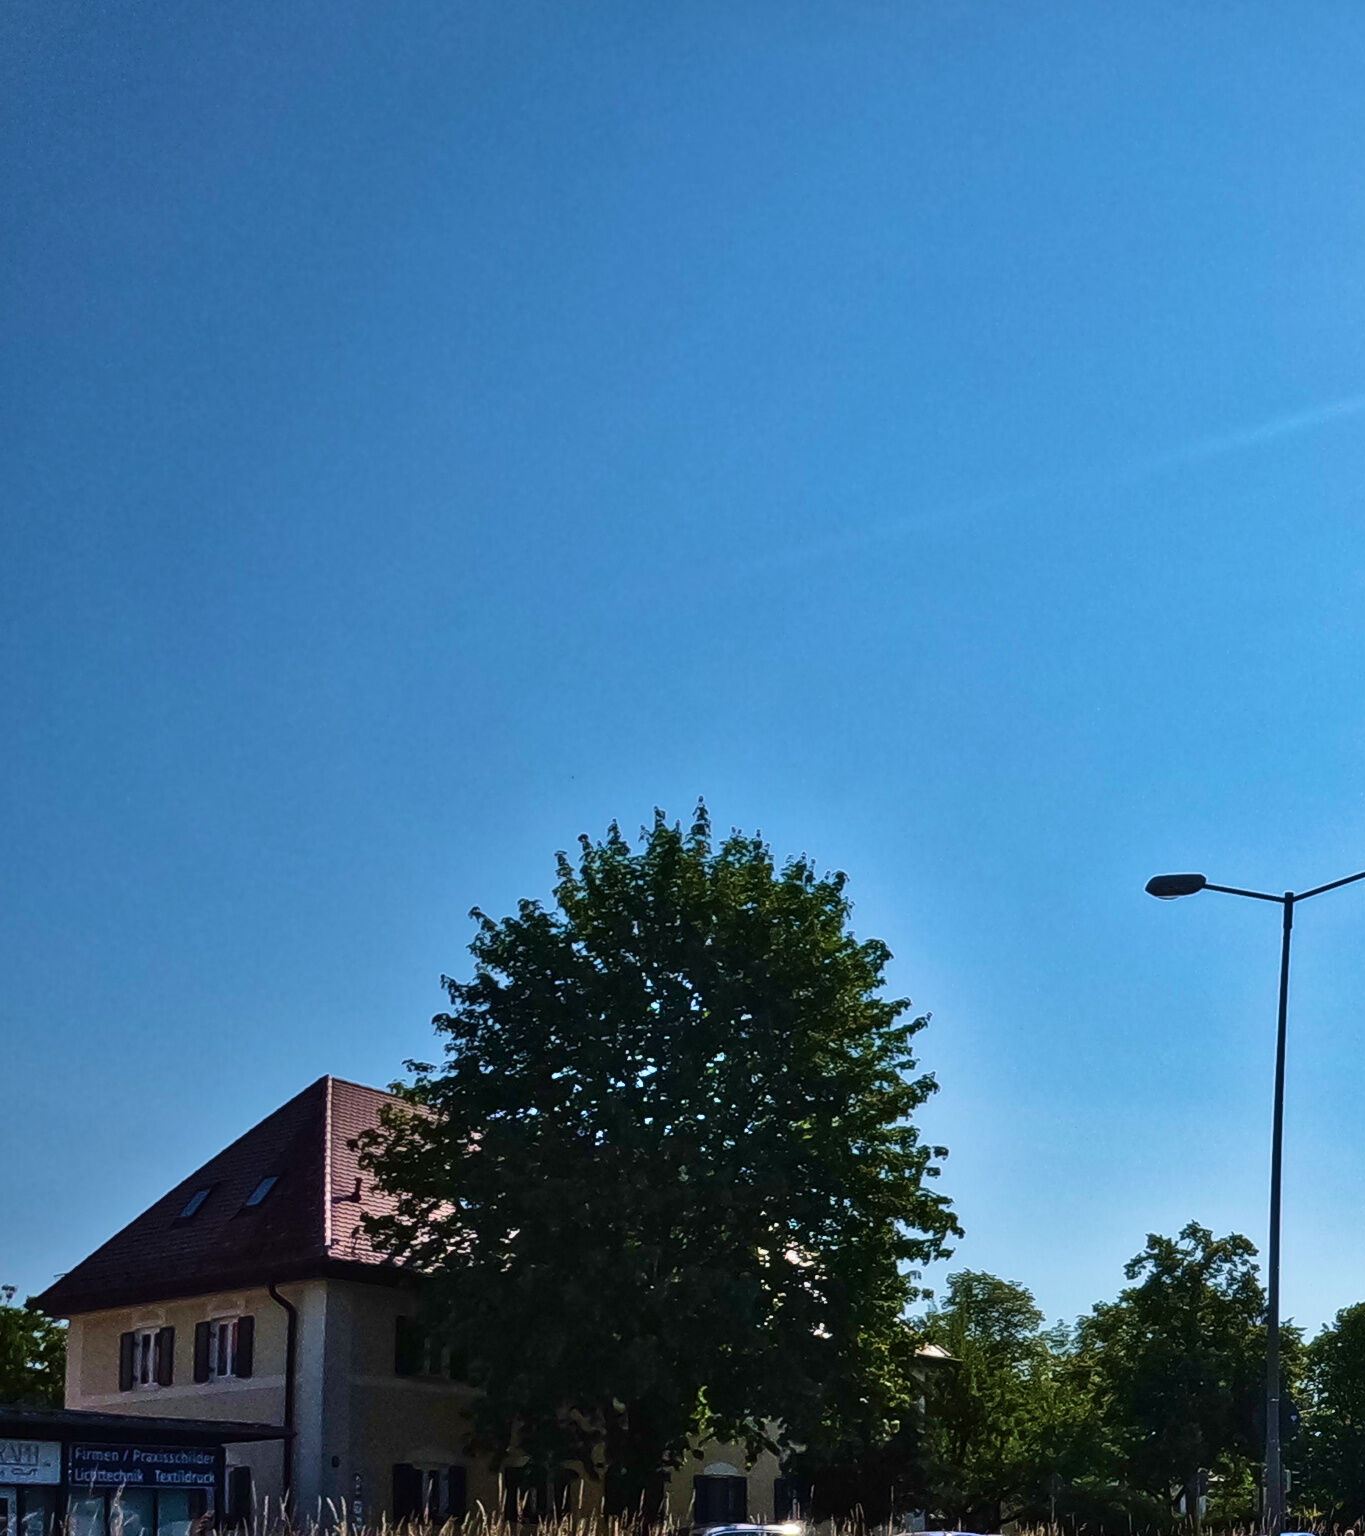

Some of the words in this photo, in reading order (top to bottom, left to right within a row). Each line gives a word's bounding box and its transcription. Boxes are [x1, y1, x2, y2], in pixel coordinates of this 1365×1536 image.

[75, 1447, 119, 1462] Firmen
[132, 1448, 215, 1464] Praxisschilder
[154, 1469, 215, 1484] Textildruck
